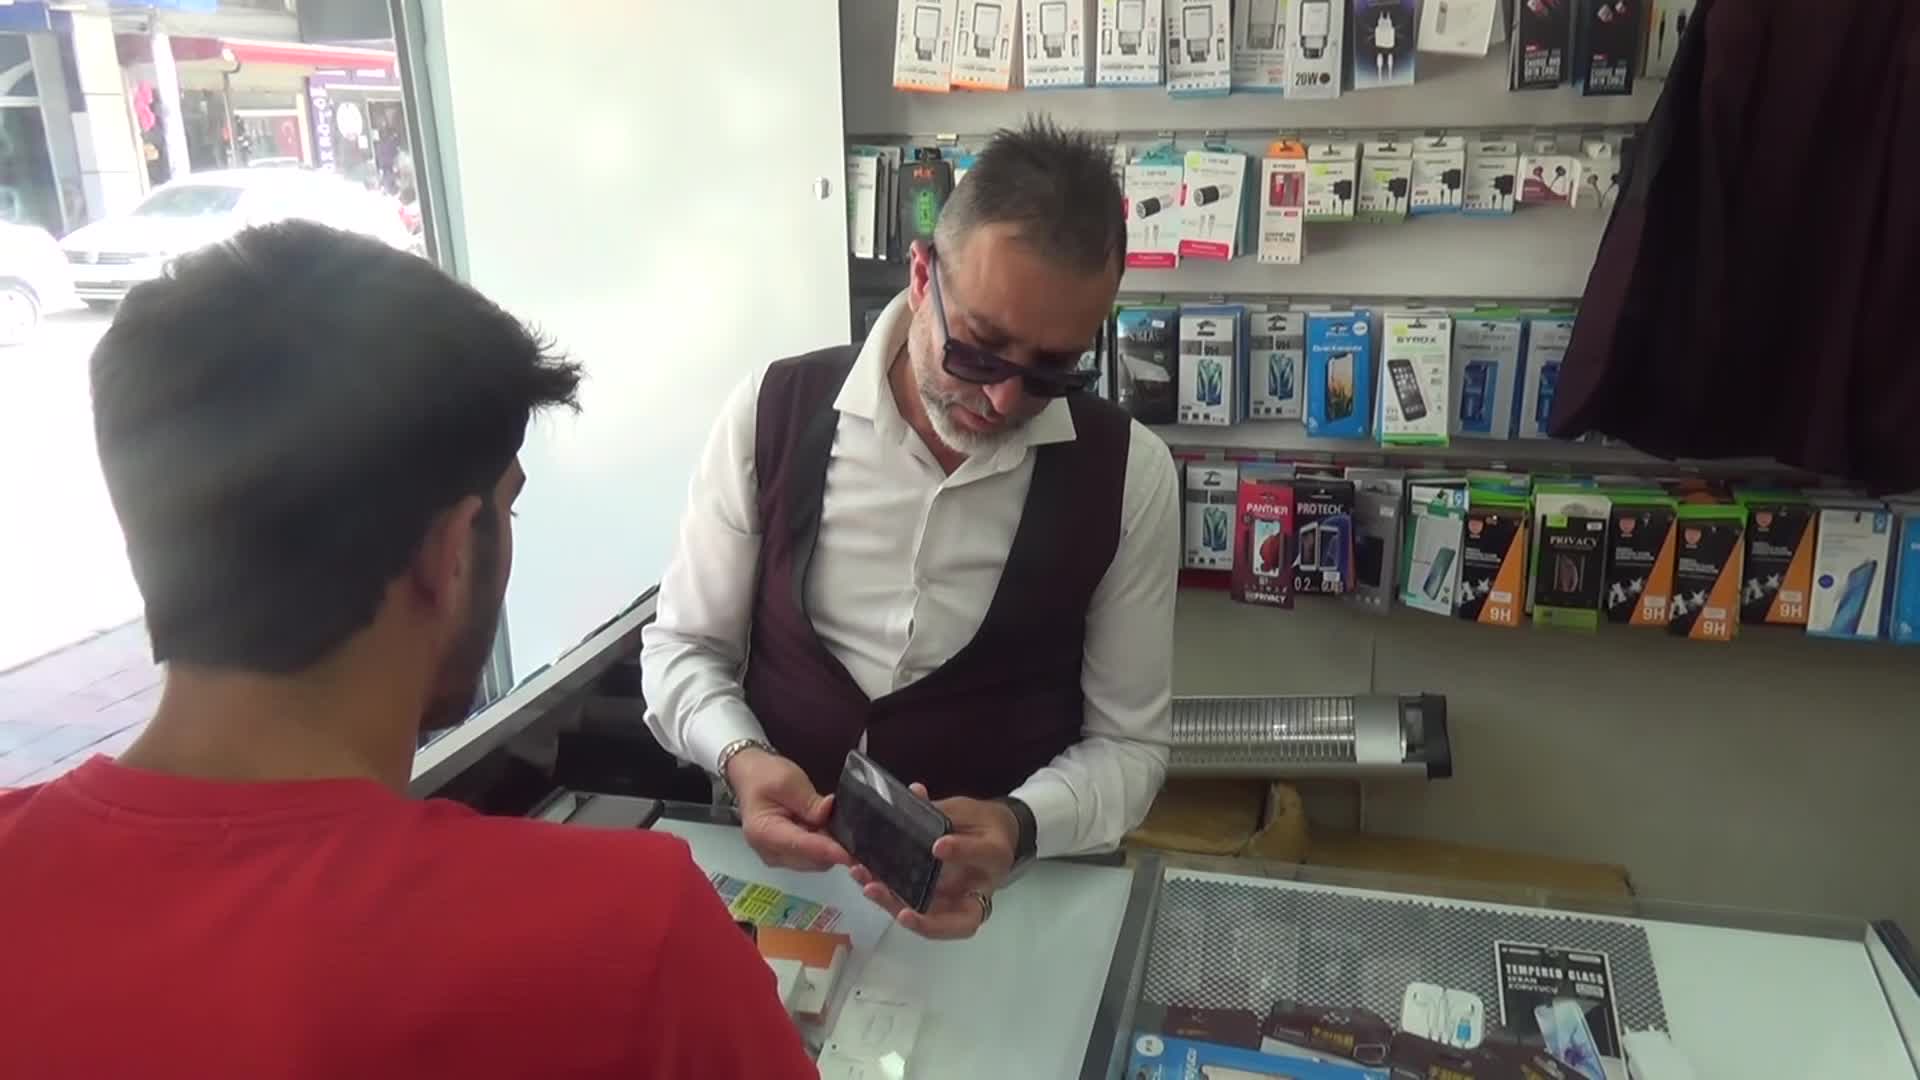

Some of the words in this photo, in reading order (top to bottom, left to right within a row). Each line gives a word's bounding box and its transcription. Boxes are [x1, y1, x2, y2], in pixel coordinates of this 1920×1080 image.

[1295, 71, 1319, 86] 20W
[1246, 503, 1289, 515] PANTHER
[1549, 535, 1598, 546] PRIVACY
[1489, 608, 1512, 622] 9H
[1643, 607, 1665, 620] 9H
[1780, 603, 1802, 617] 9H
[1703, 620, 1727, 636] 9H
[1505, 963, 1563, 980] TEMPERED
[1567, 969, 1605, 985] GLASS
